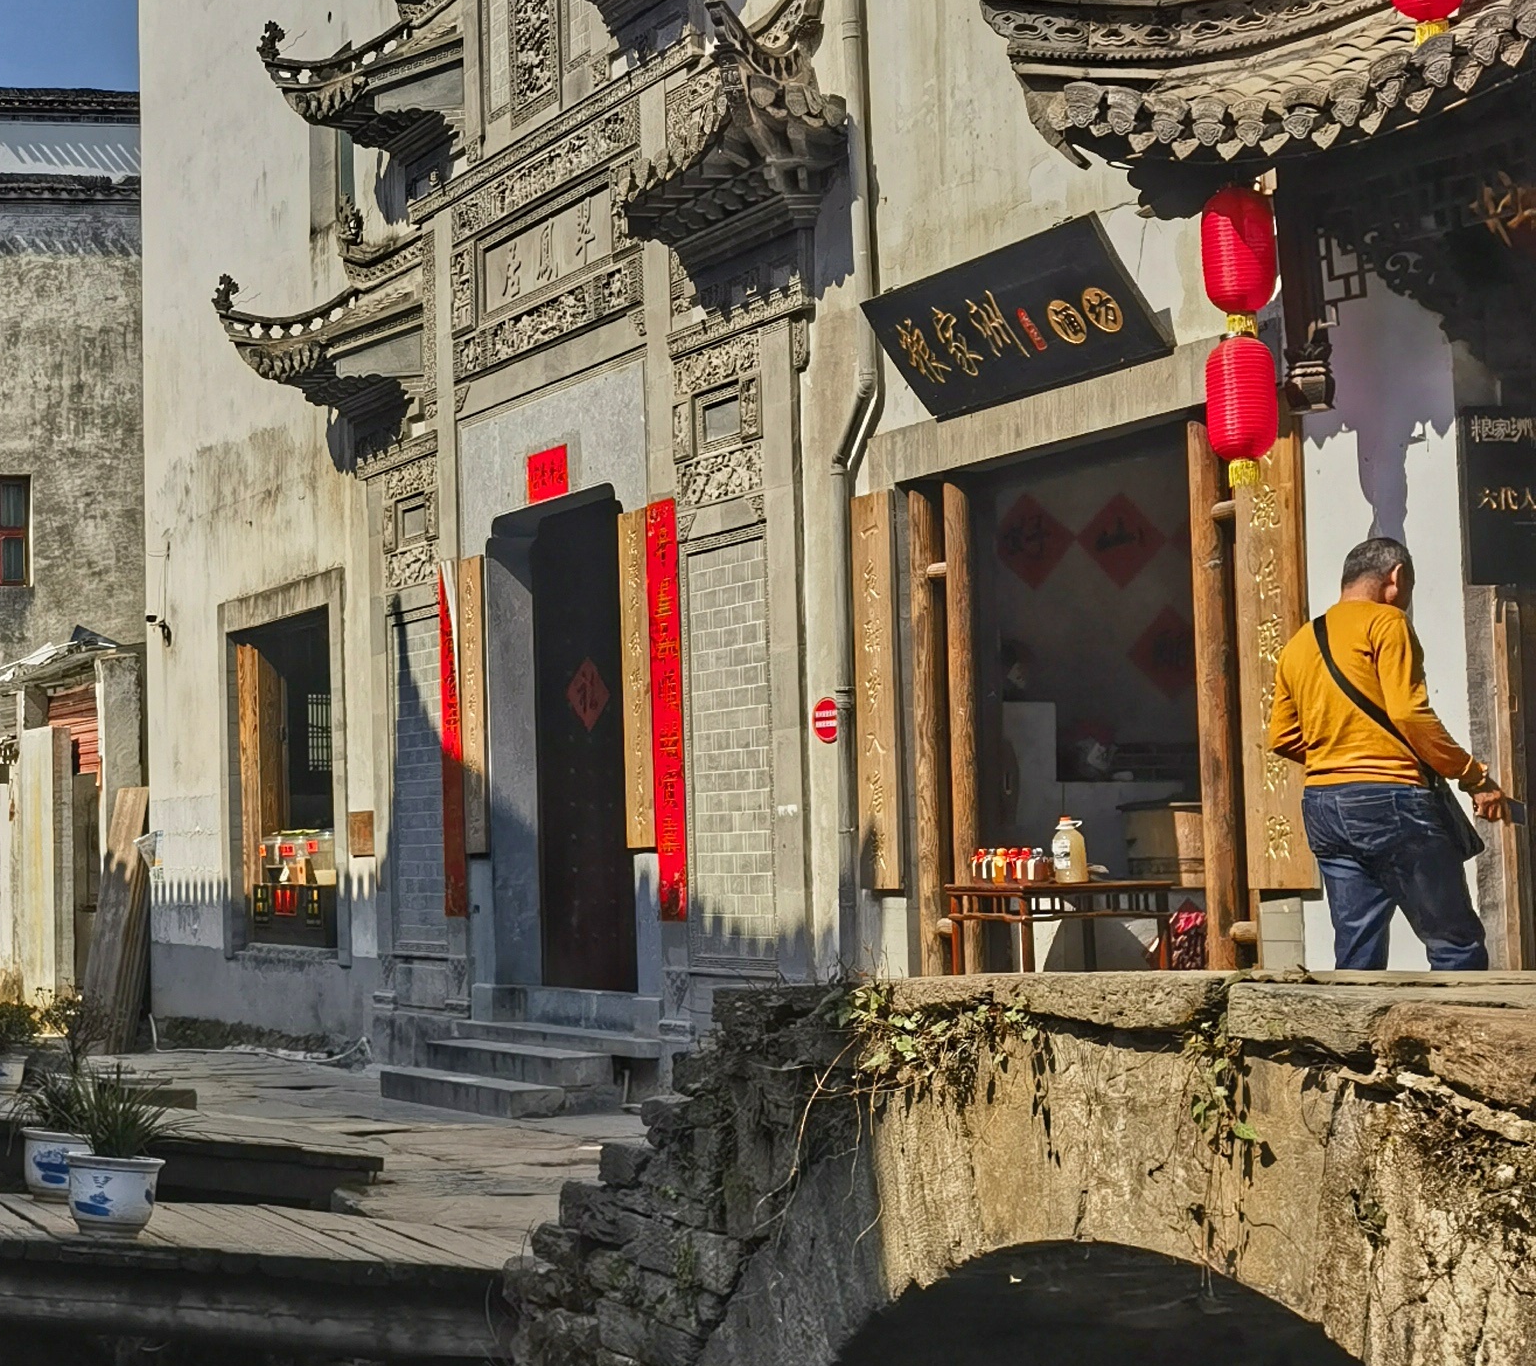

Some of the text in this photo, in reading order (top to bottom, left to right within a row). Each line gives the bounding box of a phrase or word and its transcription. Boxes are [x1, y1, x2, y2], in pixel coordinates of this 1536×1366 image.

[1049, 289, 1121, 342] 酒坊
[1471, 415, 1536, 444] 粮家洲
